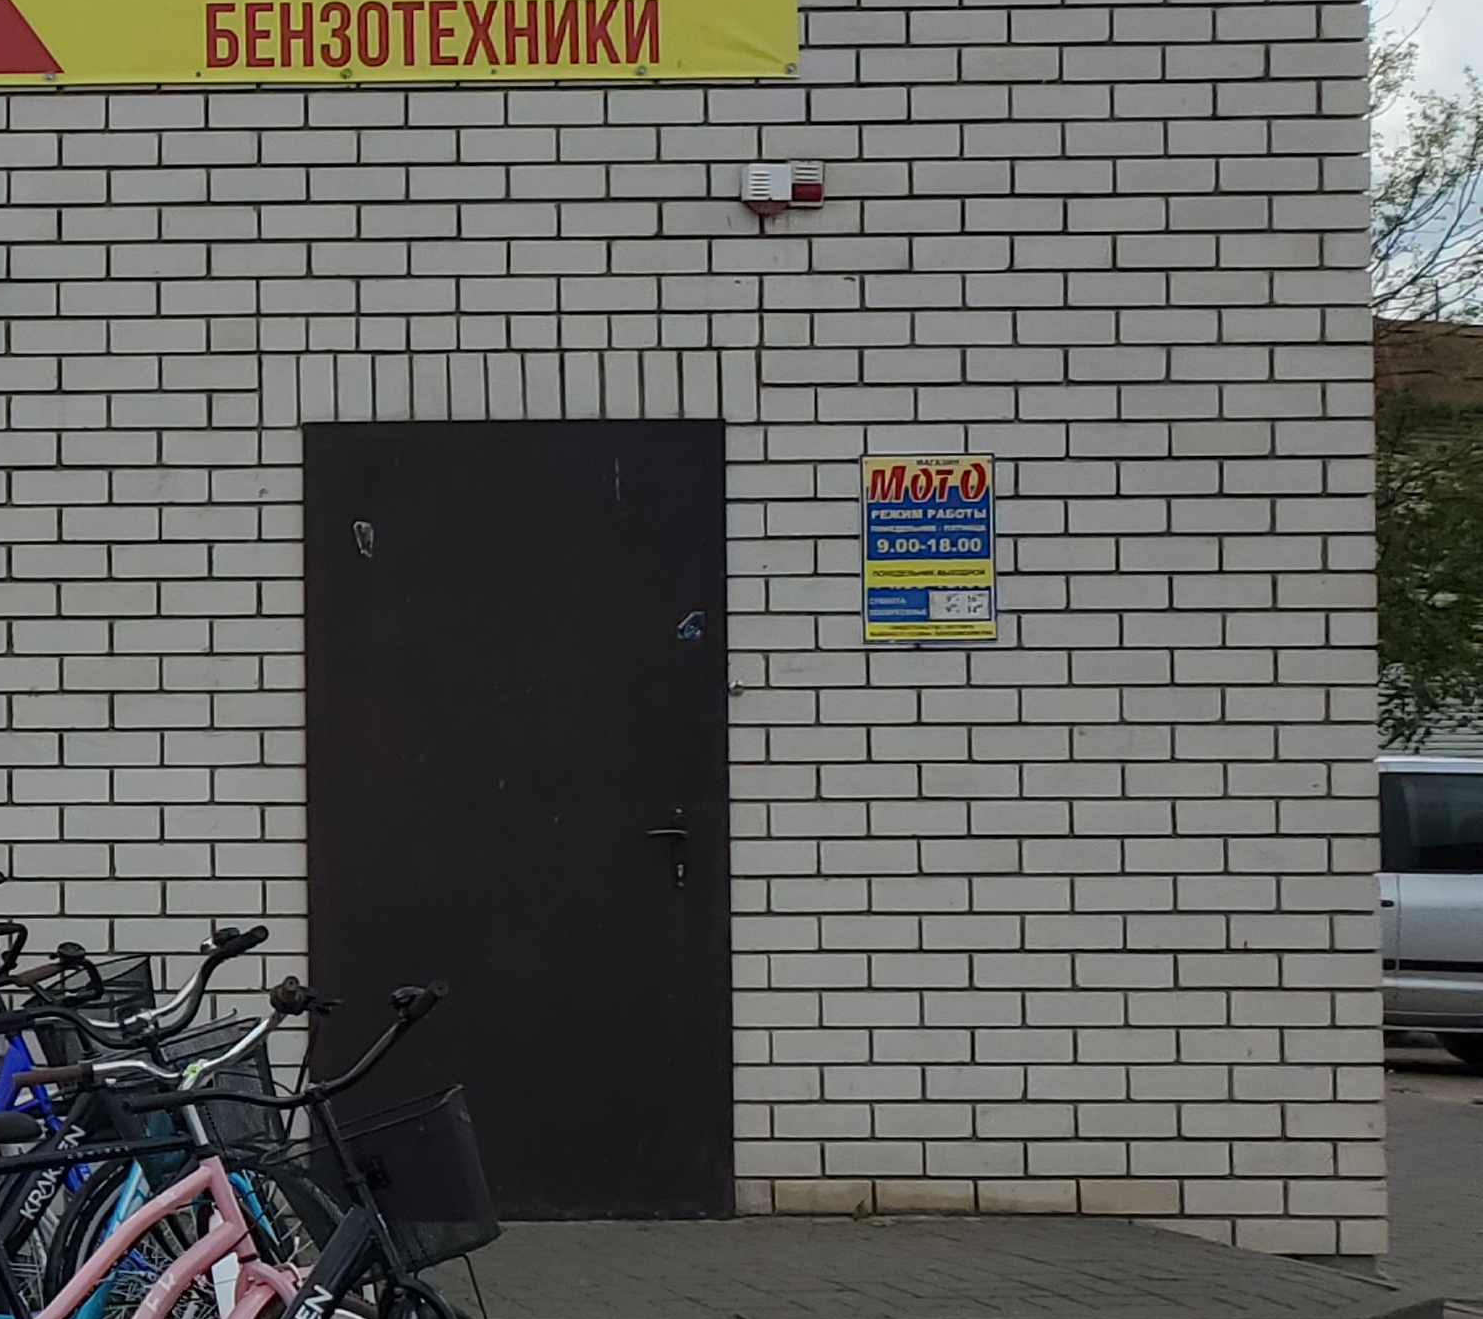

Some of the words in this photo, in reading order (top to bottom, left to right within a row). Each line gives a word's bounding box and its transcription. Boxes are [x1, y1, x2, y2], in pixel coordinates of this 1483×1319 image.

[869, 463, 987, 502] МОТО
[871, 509, 924, 520] РЕЖИМ
[927, 508, 987, 519] РАБОТЫ
[876, 538, 983, 554] 9.00-18.00
